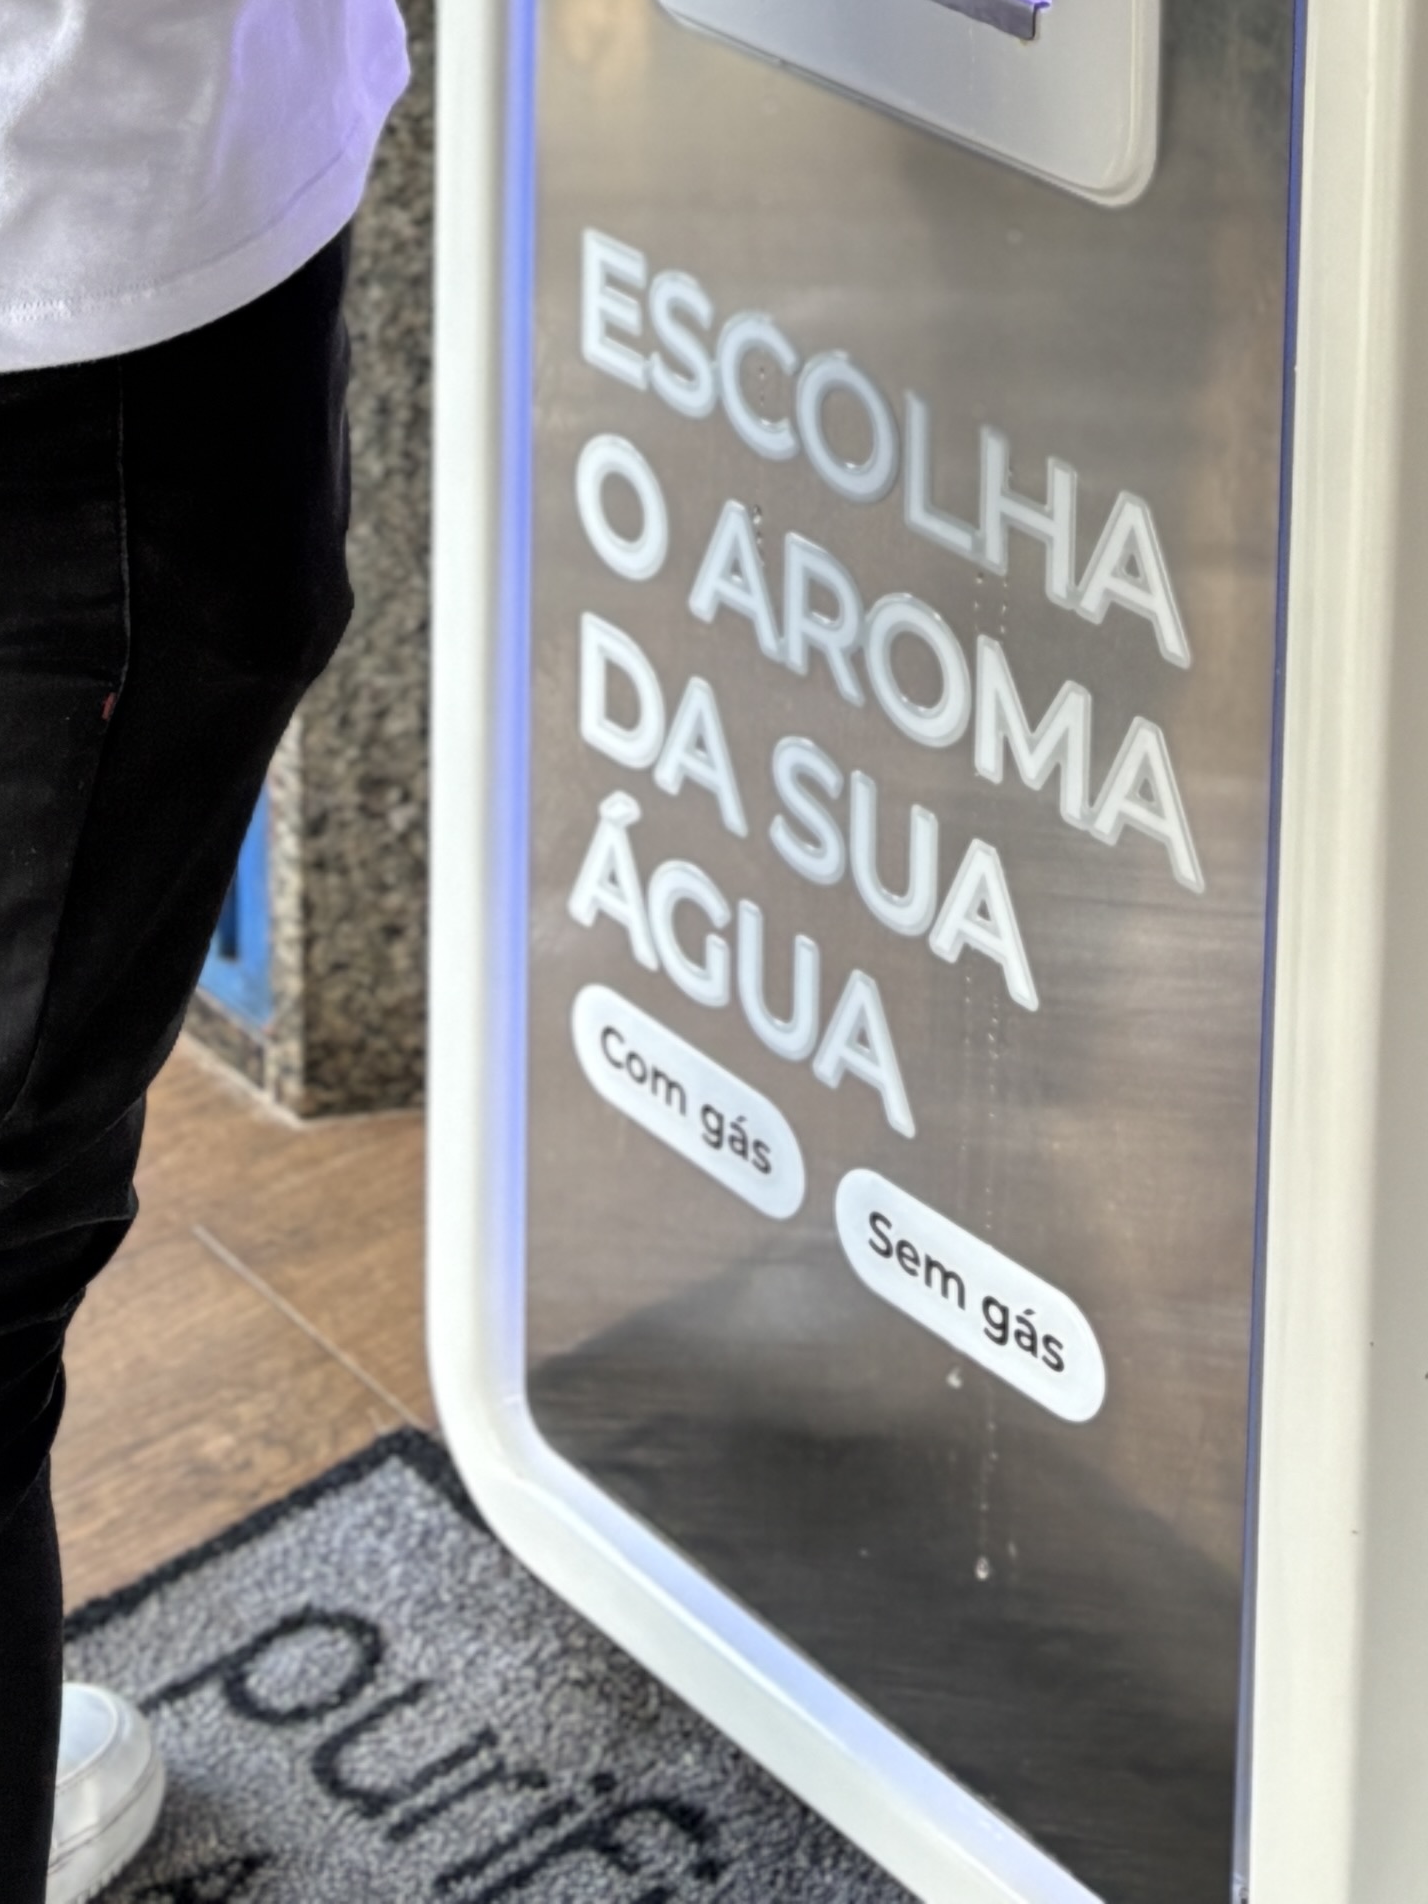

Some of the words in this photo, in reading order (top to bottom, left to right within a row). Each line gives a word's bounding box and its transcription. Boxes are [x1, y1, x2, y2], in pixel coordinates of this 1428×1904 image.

[579, 226, 1192, 669] ESCOLHA
[575, 433, 670, 581] O
[688, 497, 1206, 894] AROMA
[581, 610, 749, 838] DA
[770, 734, 1040, 1013] SUA
[568, 790, 916, 1139] ÁGUA
[597, 1023, 690, 1124] Com
[699, 1103, 775, 1182] gás
[867, 1208, 969, 1311] Sem
[980, 1298, 1067, 1377] gás
